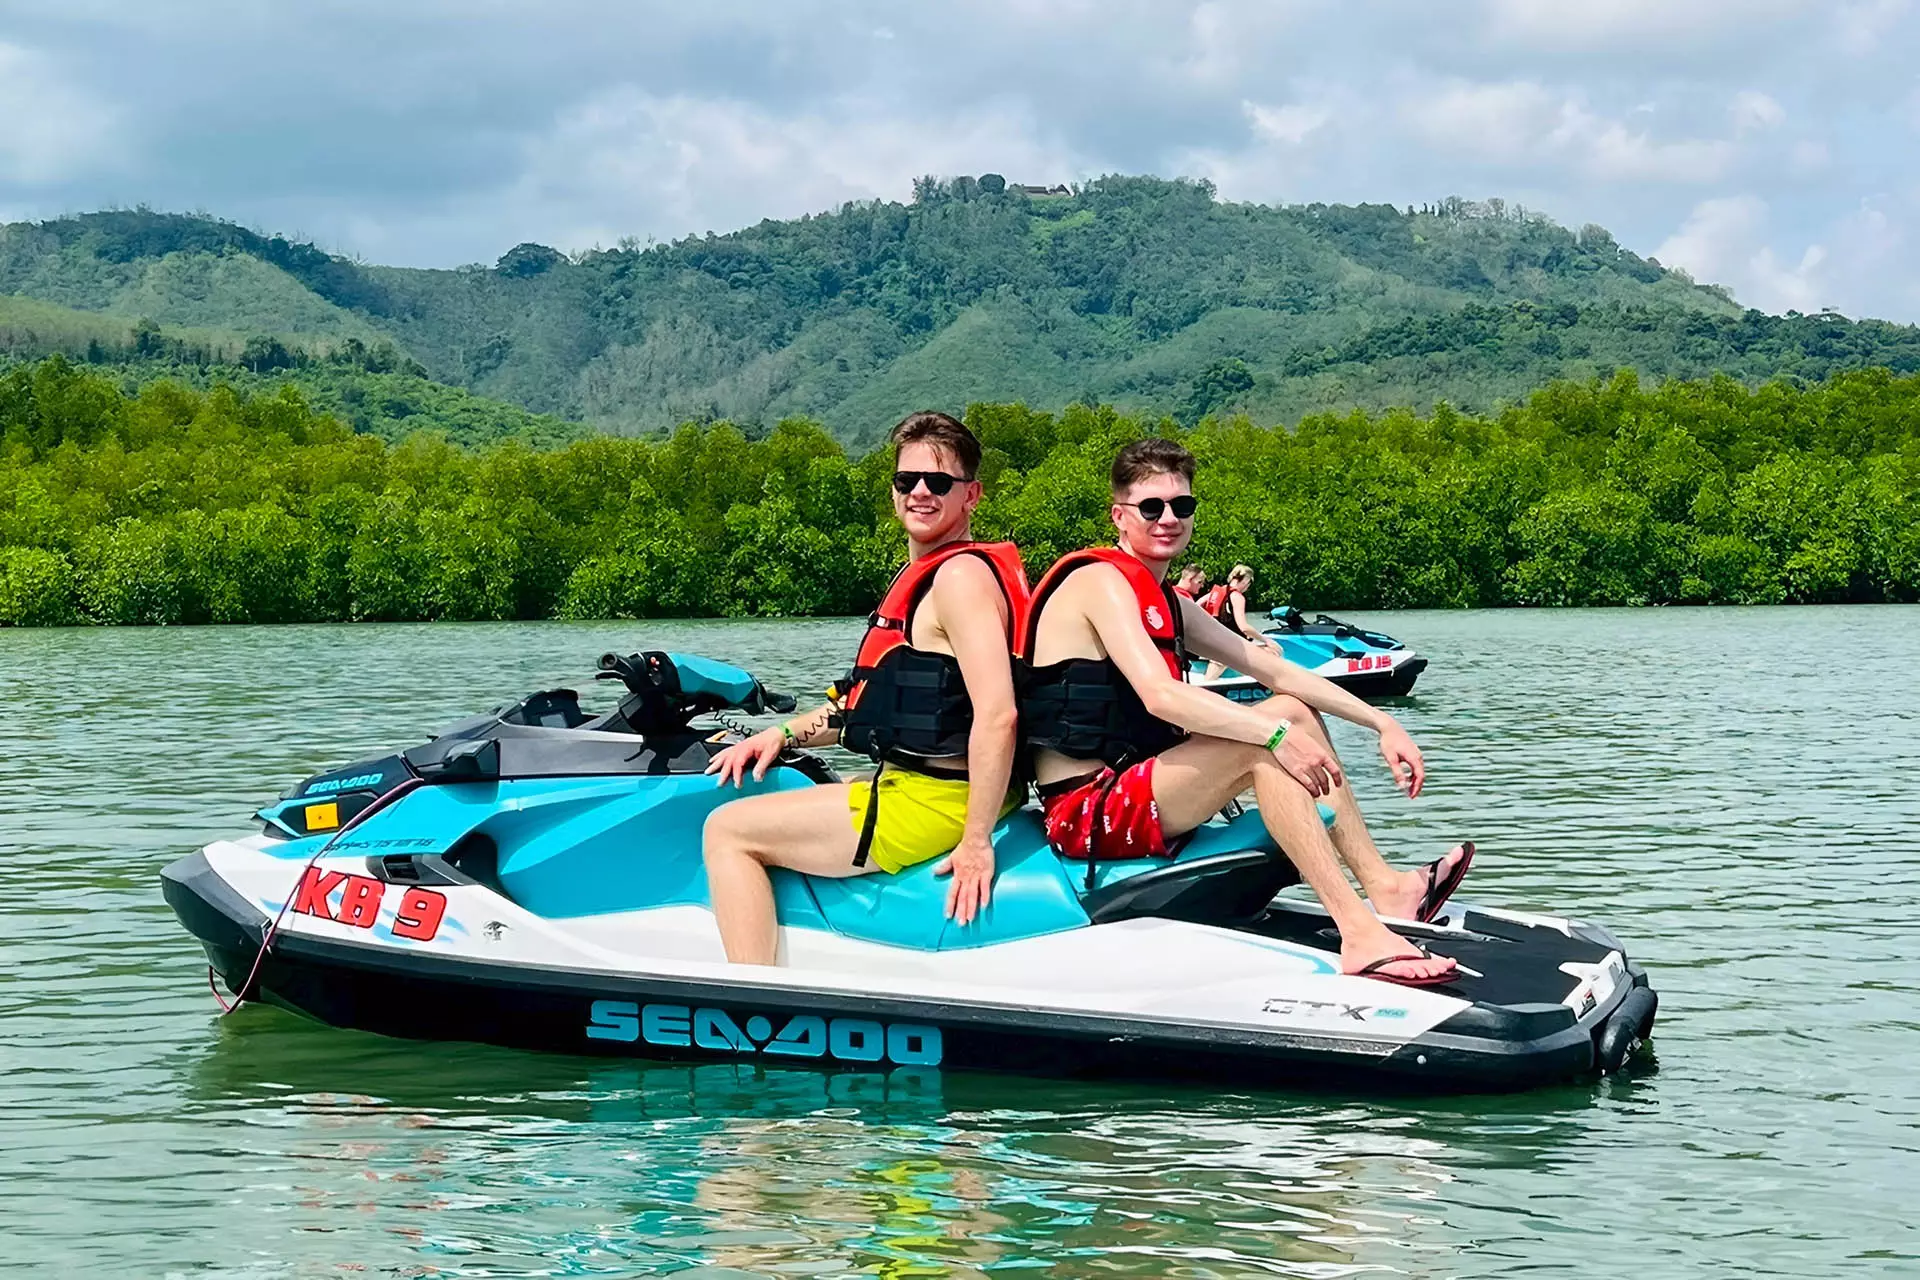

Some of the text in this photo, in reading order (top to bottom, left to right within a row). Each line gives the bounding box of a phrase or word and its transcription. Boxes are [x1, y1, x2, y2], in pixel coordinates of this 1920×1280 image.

[291, 864, 448, 942] KB 9
[1261, 998, 1373, 1022] GTX
